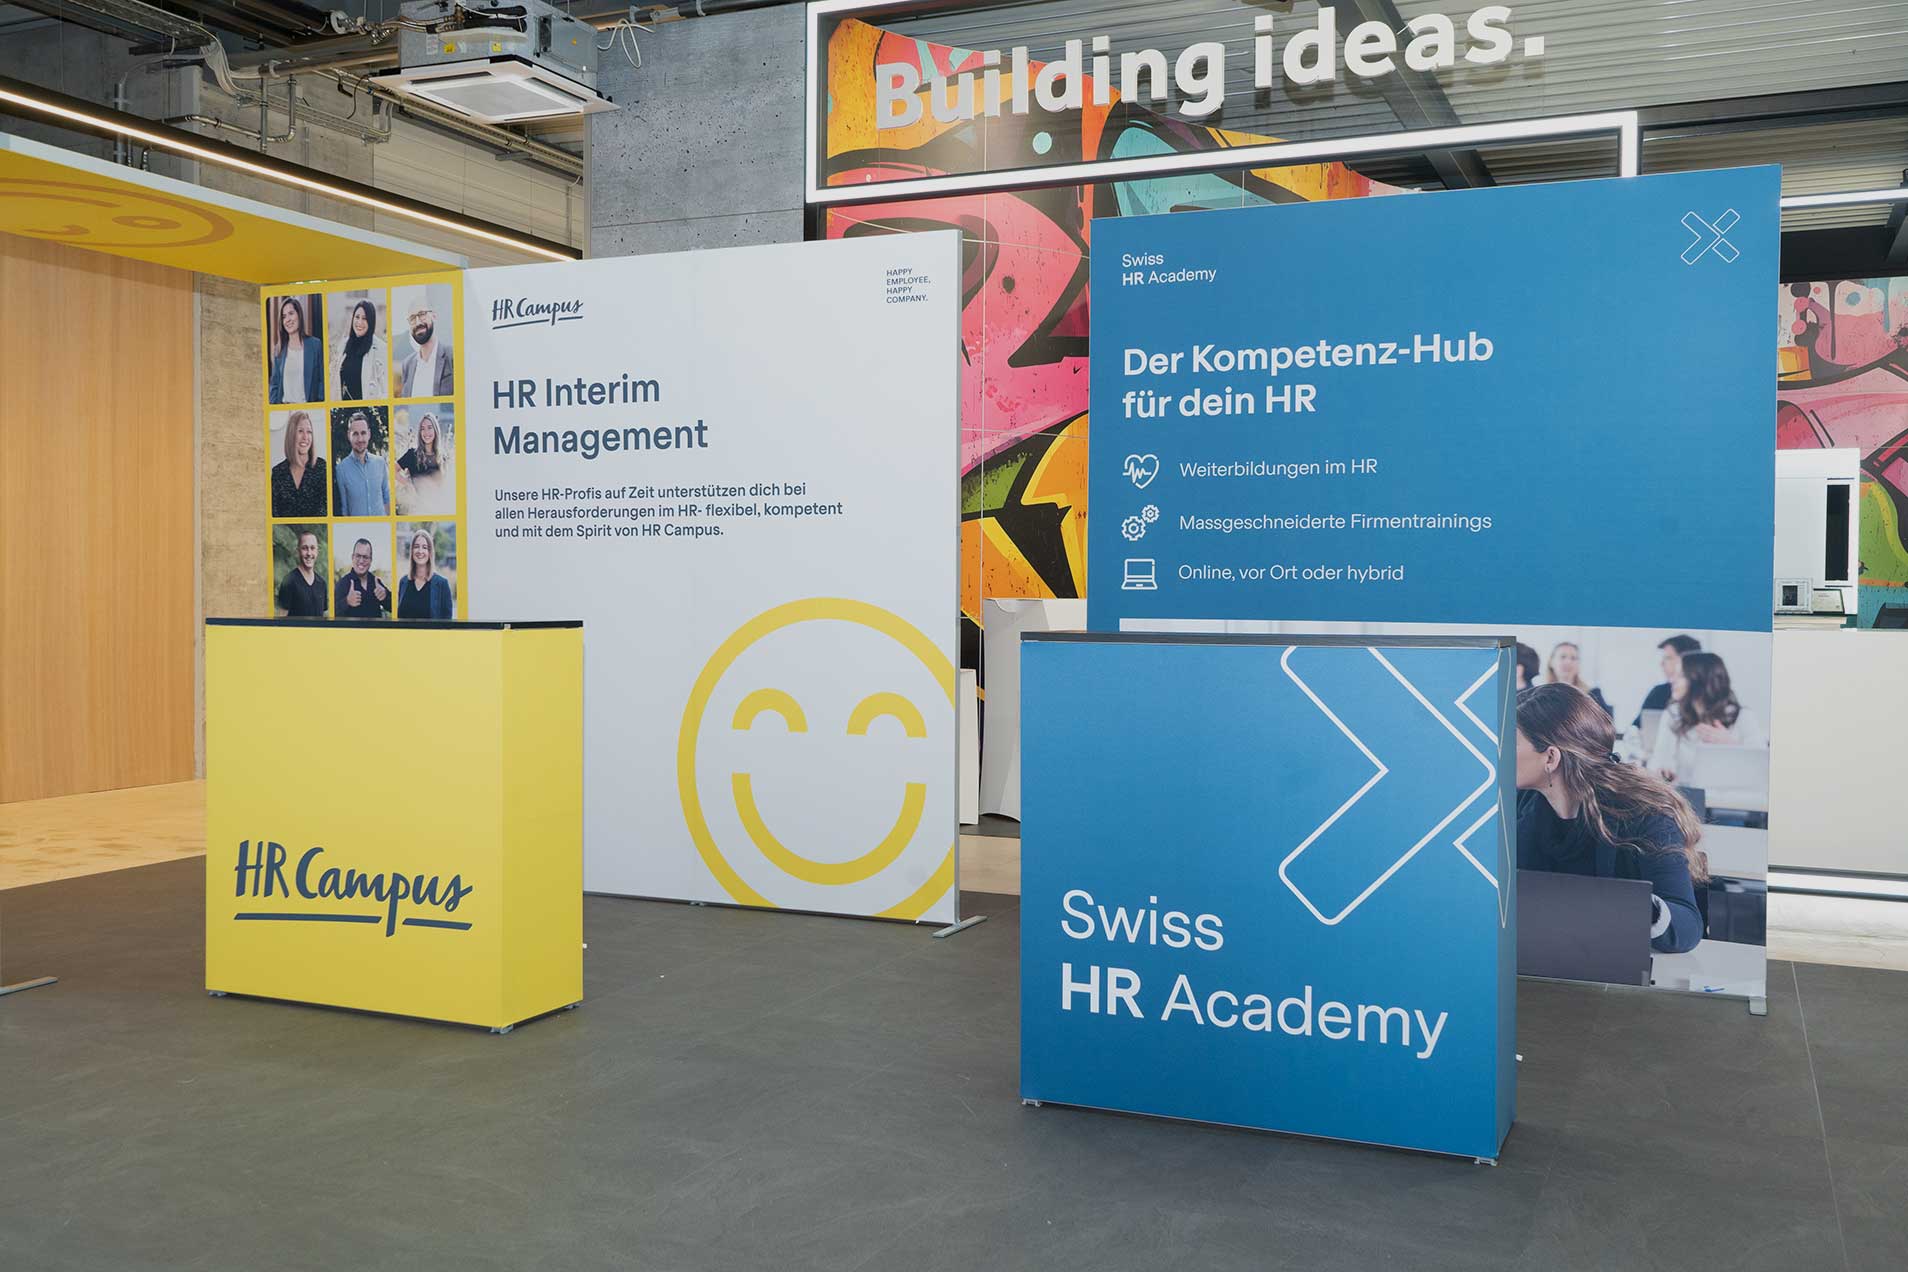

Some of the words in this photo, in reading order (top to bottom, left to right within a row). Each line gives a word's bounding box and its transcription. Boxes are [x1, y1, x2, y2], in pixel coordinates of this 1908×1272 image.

[875, 36, 1225, 130] Building
[1253, 4, 1546, 89] ideas.
[1122, 253, 1164, 267] Swiss
[886, 268, 913, 276] HAPPY
[886, 276, 931, 285] EMPLOYEE,
[1122, 272, 1145, 286] HR
[1147, 268, 1217, 284] Academy
[886, 286, 913, 294] HAPPY
[886, 294, 928, 303] COMPANY.
[492, 298, 515, 322] HR
[516, 297, 584, 326] Campus
[1124, 348, 1185, 376] Der
[1192, 331, 1494, 378] Kompetenz-Hub
[493, 379, 537, 409] HR
[546, 373, 660, 407] Interim
[1122, 389, 1172, 419] für
[1178, 386, 1255, 417] dein
[1265, 384, 1317, 414] HR
[494, 419, 708, 460] Management
[1179, 460, 1320, 479] Weiterbildungen
[1325, 459, 1346, 475] im
[1351, 458, 1378, 474] HR
[495, 489, 539, 502] Unsere
[541, 486, 602, 501] HR-Profis
[604, 486, 627, 500] auf
[628, 485, 655, 499] Zeit
[657, 484, 746, 499] unterstützen
[749, 483, 780, 497] dich
[784, 482, 806, 496] bei
[494, 507, 525, 520] allen
[527, 505, 656, 521] Herausforderungen
[658, 504, 675, 518] im
[678, 504, 703, 518] HR-
[705, 502, 761, 518] flexibel,
[764, 501, 843, 519] kompetent
[495, 525, 519, 538] und
[522, 524, 543, 538] mit
[545, 524, 574, 538] dem
[576, 523, 612, 540] Spirit
[614, 526, 639, 537] von
[642, 523, 661, 537] HR
[664, 523, 724, 539] Campus.
[1179, 514, 1346, 534] Massgeschneiderte
[1350, 513, 1492, 533] Firmentrainings
[1178, 564, 1236, 582] Online,
[1238, 568, 1267, 580] vor
[1269, 564, 1298, 580] Ort
[1302, 564, 1344, 580] oder
[1347, 564, 1404, 584] hybrid
[234, 839, 290, 899] HR
[295, 846, 473, 938] Campus
[1061, 889, 1224, 951] Swiss
[1061, 962, 1145, 1019] HR
[1160, 973, 1449, 1060] Academy
